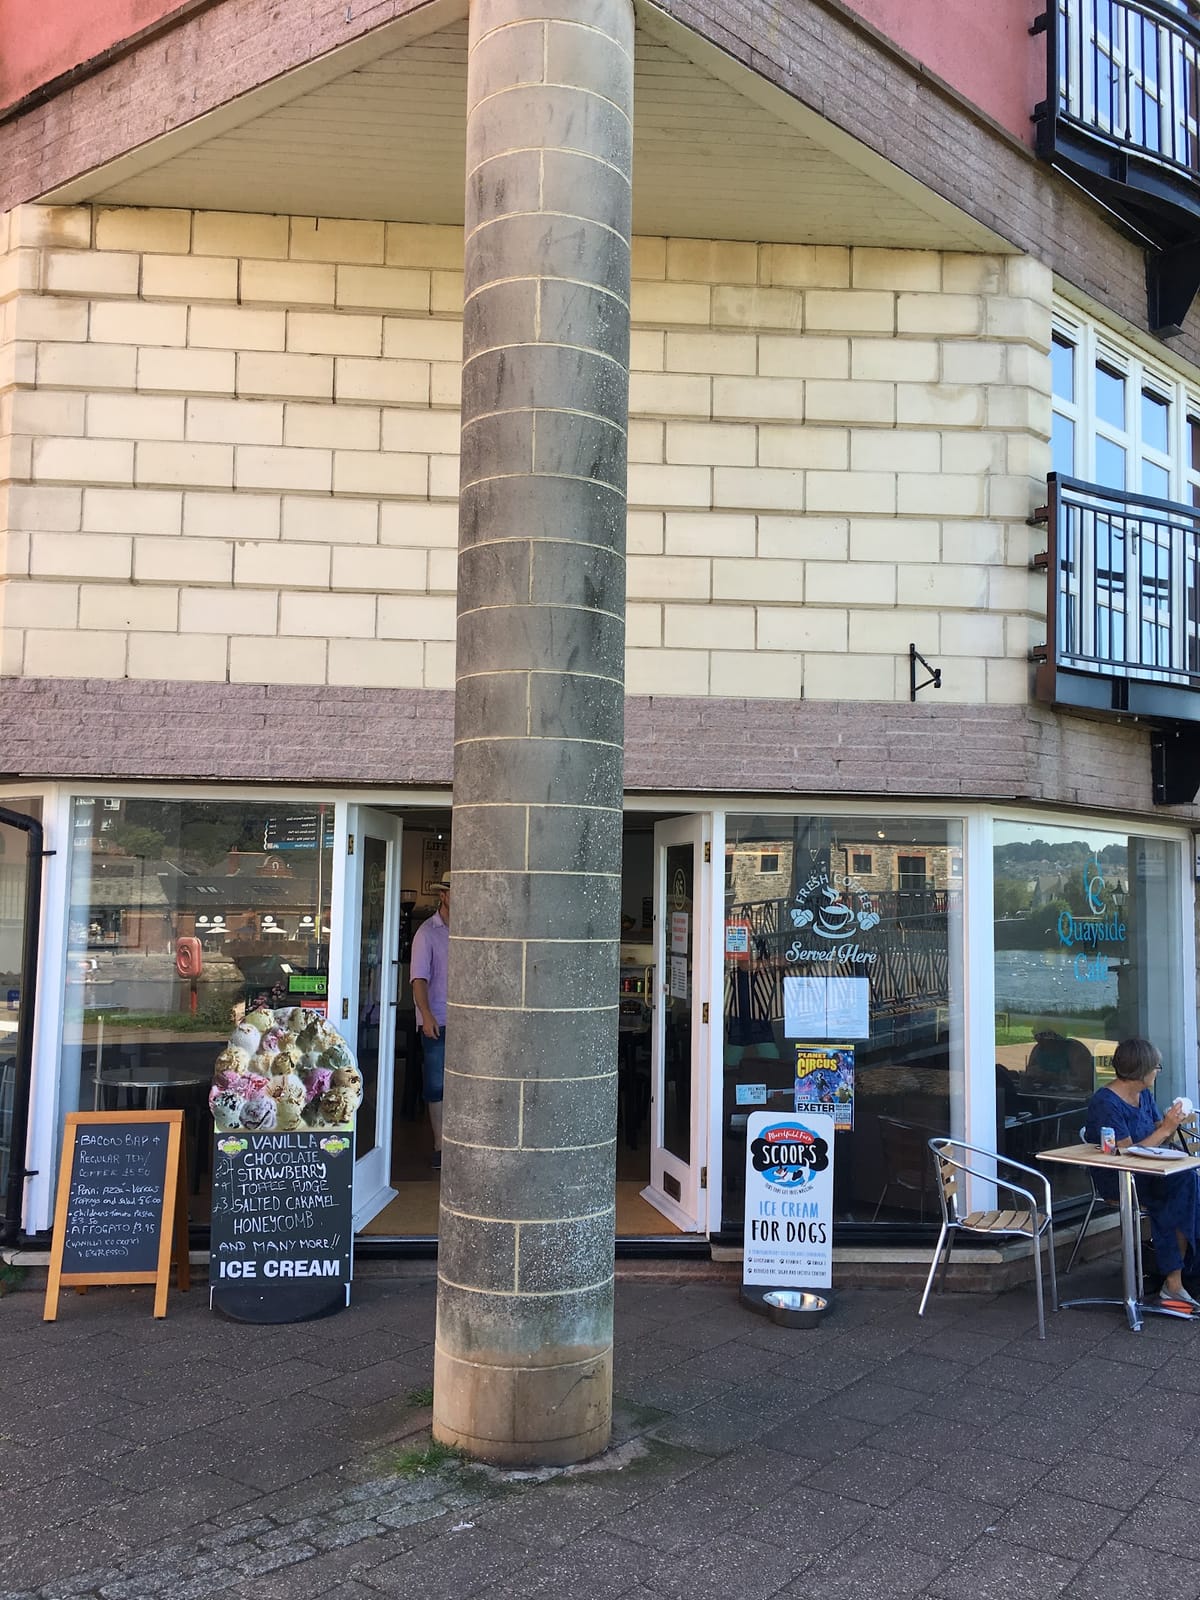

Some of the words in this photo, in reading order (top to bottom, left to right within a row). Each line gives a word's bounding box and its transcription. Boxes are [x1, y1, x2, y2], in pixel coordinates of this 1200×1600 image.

[795, 873, 829, 904] FRESH
[834, 873, 873, 910] COFFEE
[1057, 911, 1126, 948] Quayside
[785, 940, 836, 962] Served
[838, 943, 877, 965] Here
[1073, 952, 1109, 982] Café
[797, 1058, 838, 1078] CIRCUS
[797, 1103, 835, 1112] EXETER
[80, 1134, 122, 1146] BACON
[251, 1133, 318, 1150] VANILLA
[80, 1150, 120, 1164] REGULAR
[243, 1151, 320, 1166] CHOCOLATE
[238, 1162, 326, 1182] STRAWBERRY
[237, 1180, 287, 1196] TOFFEE
[292, 1180, 329, 1193] FUDGE
[234, 1195, 281, 1213] SALTED
[285, 1195, 340, 1211] CARAMEL
[760, 1200, 777, 1216] ICE
[781, 1201, 819, 1219] CREAM
[71, 1223, 130, 1235] AFFOGATO
[233, 1211, 314, 1235] HONEYCOMB
[752, 1219, 780, 1241] FOR
[786, 1221, 827, 1243] DOGS
[219, 1240, 246, 1251] AND
[253, 1239, 297, 1252] MANY
[220, 1260, 257, 1278] ICE
[263, 1259, 340, 1278] CREAM
